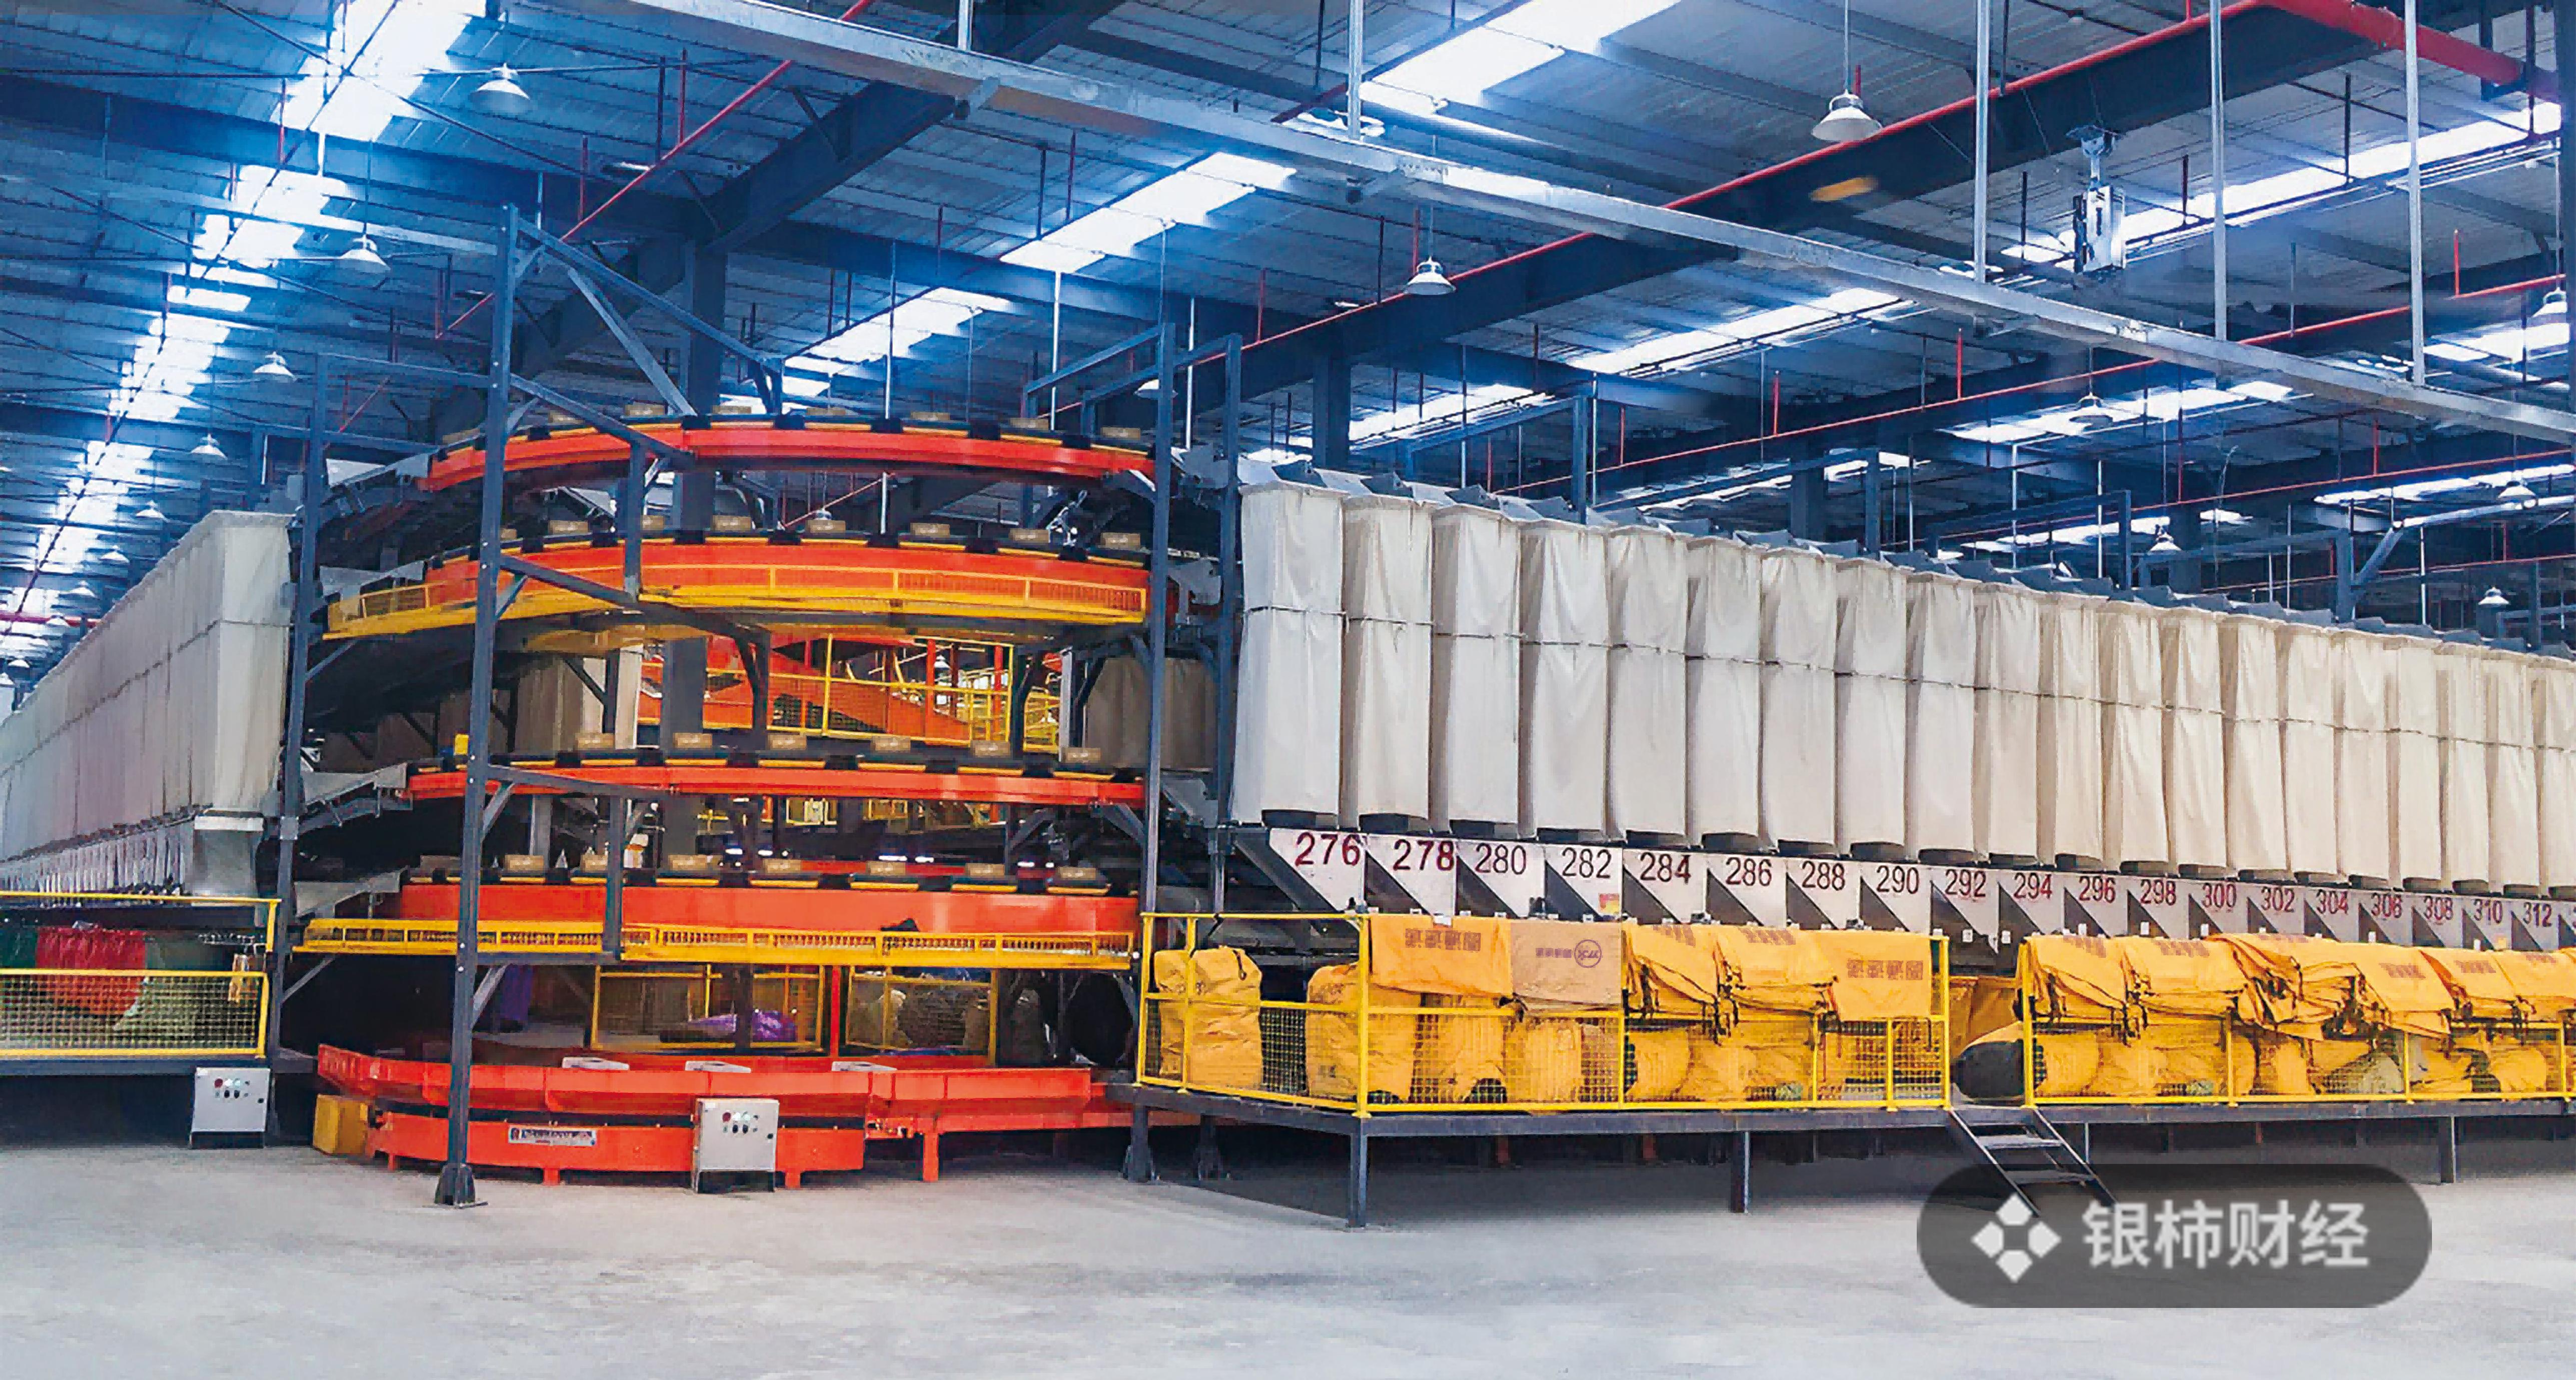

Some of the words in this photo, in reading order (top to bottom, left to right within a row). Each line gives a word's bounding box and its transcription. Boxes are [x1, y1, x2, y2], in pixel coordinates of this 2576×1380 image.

[1295, 832, 1361, 866] 276
[1393, 839, 1455, 871] 278
[1475, 844, 1527, 875] 280
[1562, 847, 1612, 879] 282
[1640, 852, 1691, 884] 284
[1726, 857, 1772, 886] 286
[1802, 861, 1845, 890] 288
[1876, 865, 1919, 894] 290
[1945, 869, 1986, 897] 292
[2013, 872, 2053, 899] 294
[2079, 876, 2115, 903] 296
[2140, 879, 2176, 906] 298
[2202, 882, 2236, 908] 300
[2261, 886, 2295, 912] 302
[2316, 889, 2348, 915] 304
[2371, 893, 2403, 918] 306
[2423, 895, 2453, 921] 308
[2473, 899, 2503, 924] 310
[2523, 901, 2552, 927] 312
